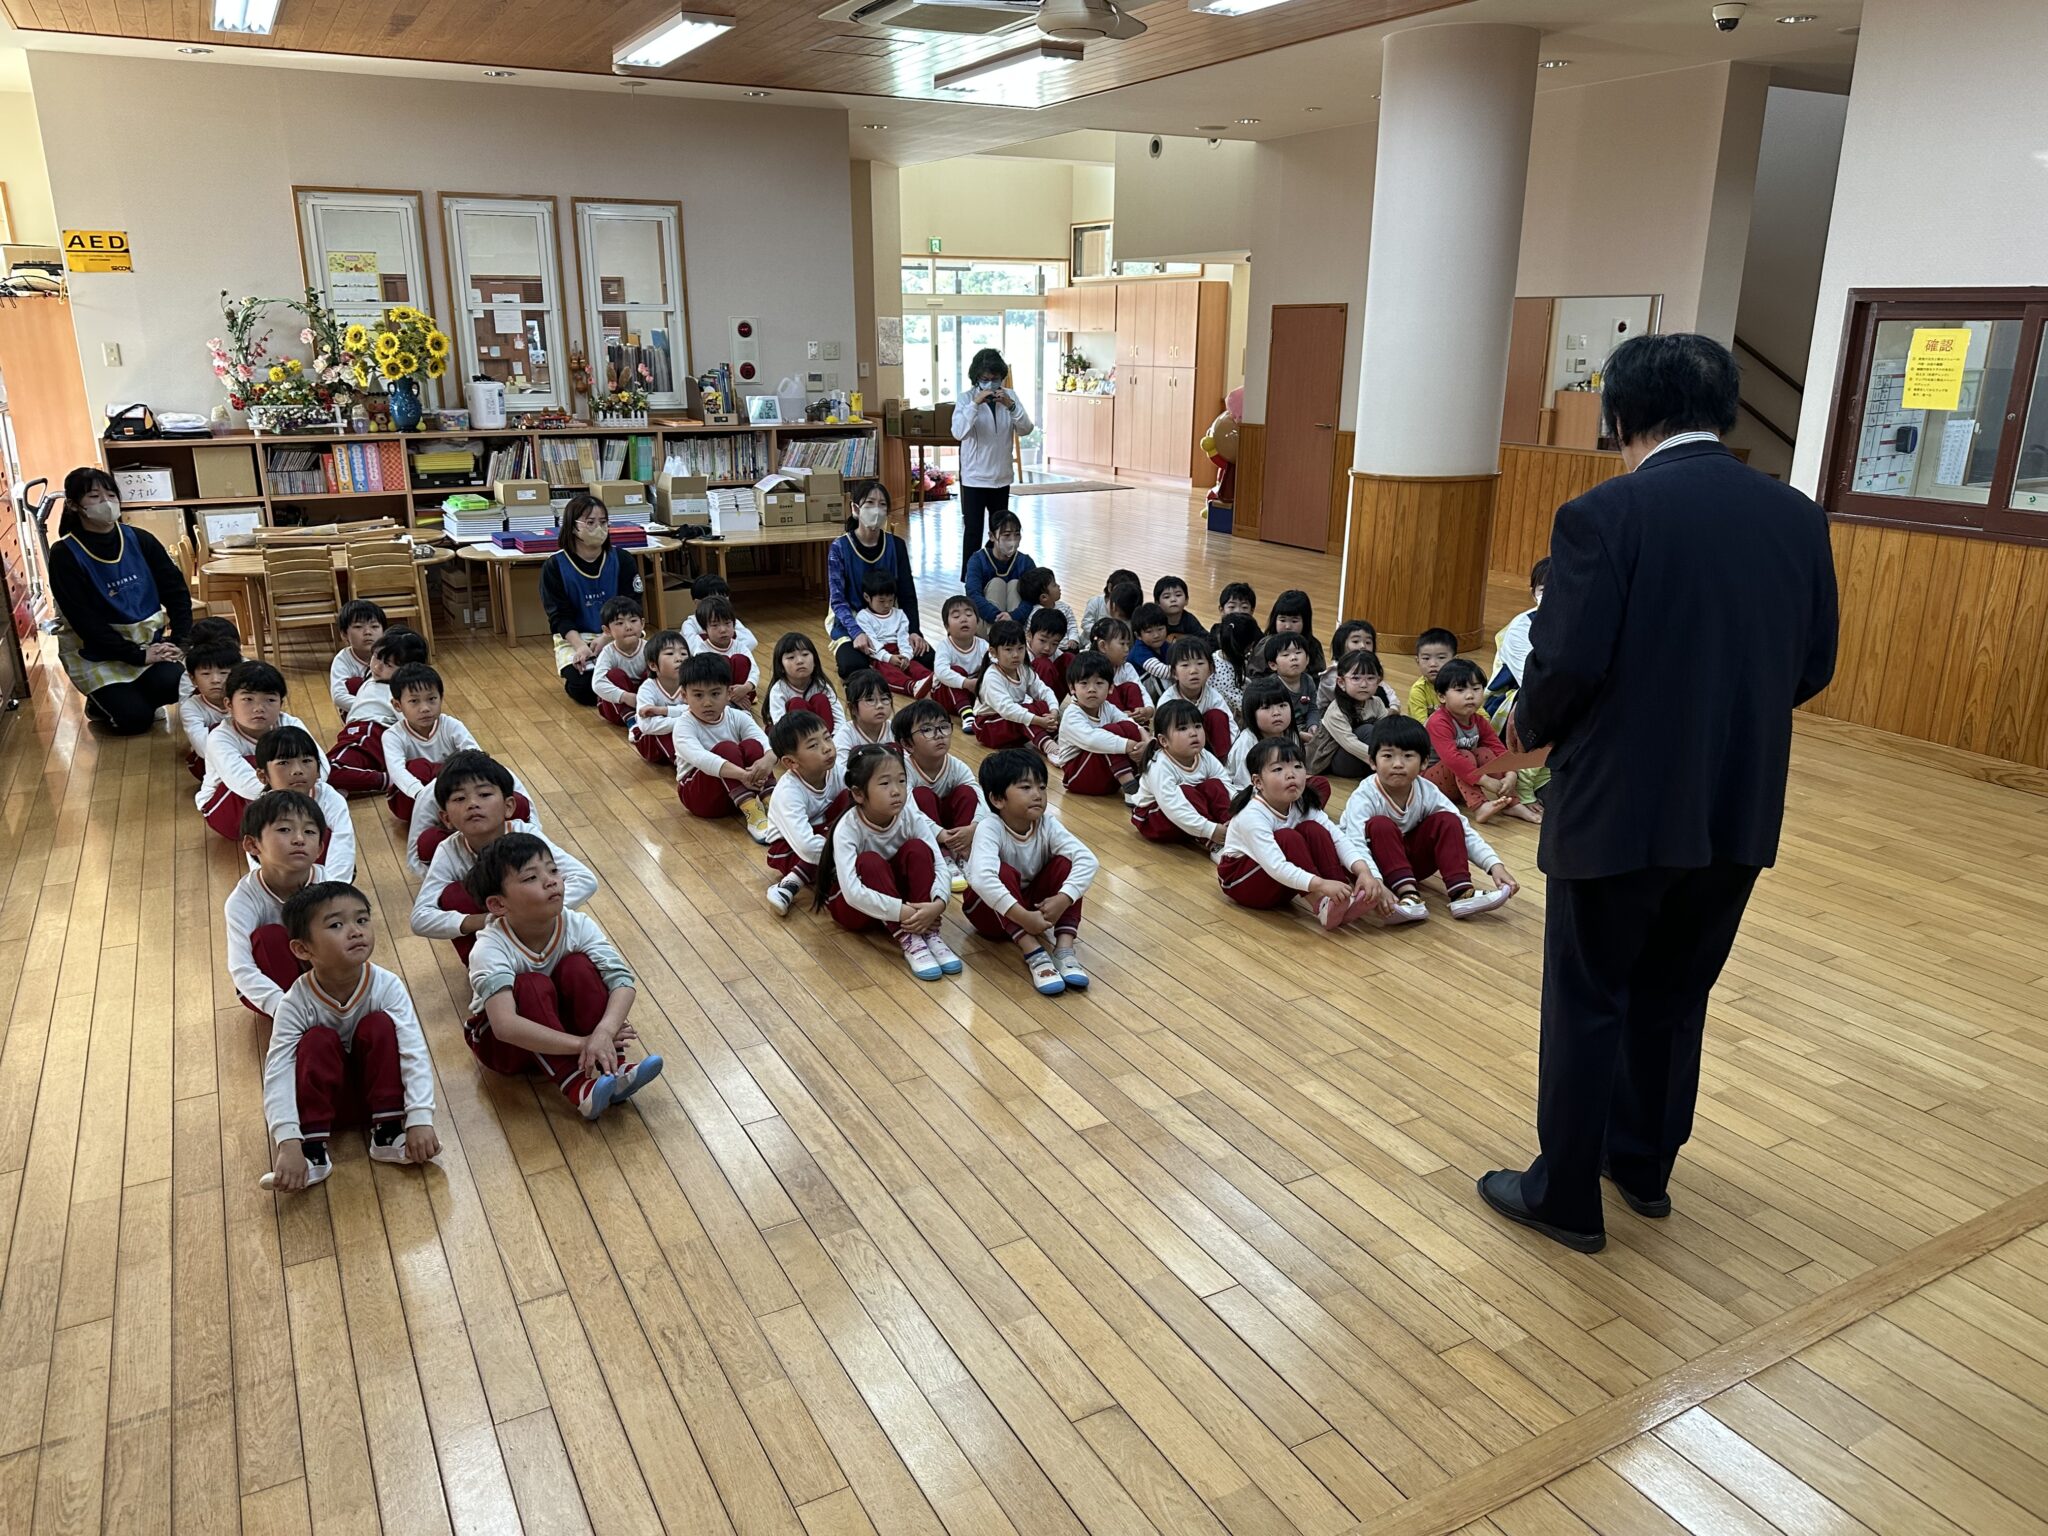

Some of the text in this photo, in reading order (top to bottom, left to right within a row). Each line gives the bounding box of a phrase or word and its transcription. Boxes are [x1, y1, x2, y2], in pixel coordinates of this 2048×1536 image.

[68, 235, 125, 249] AED
[1925, 338, 1954, 352] 確認
[128, 488, 158, 500] タオル
